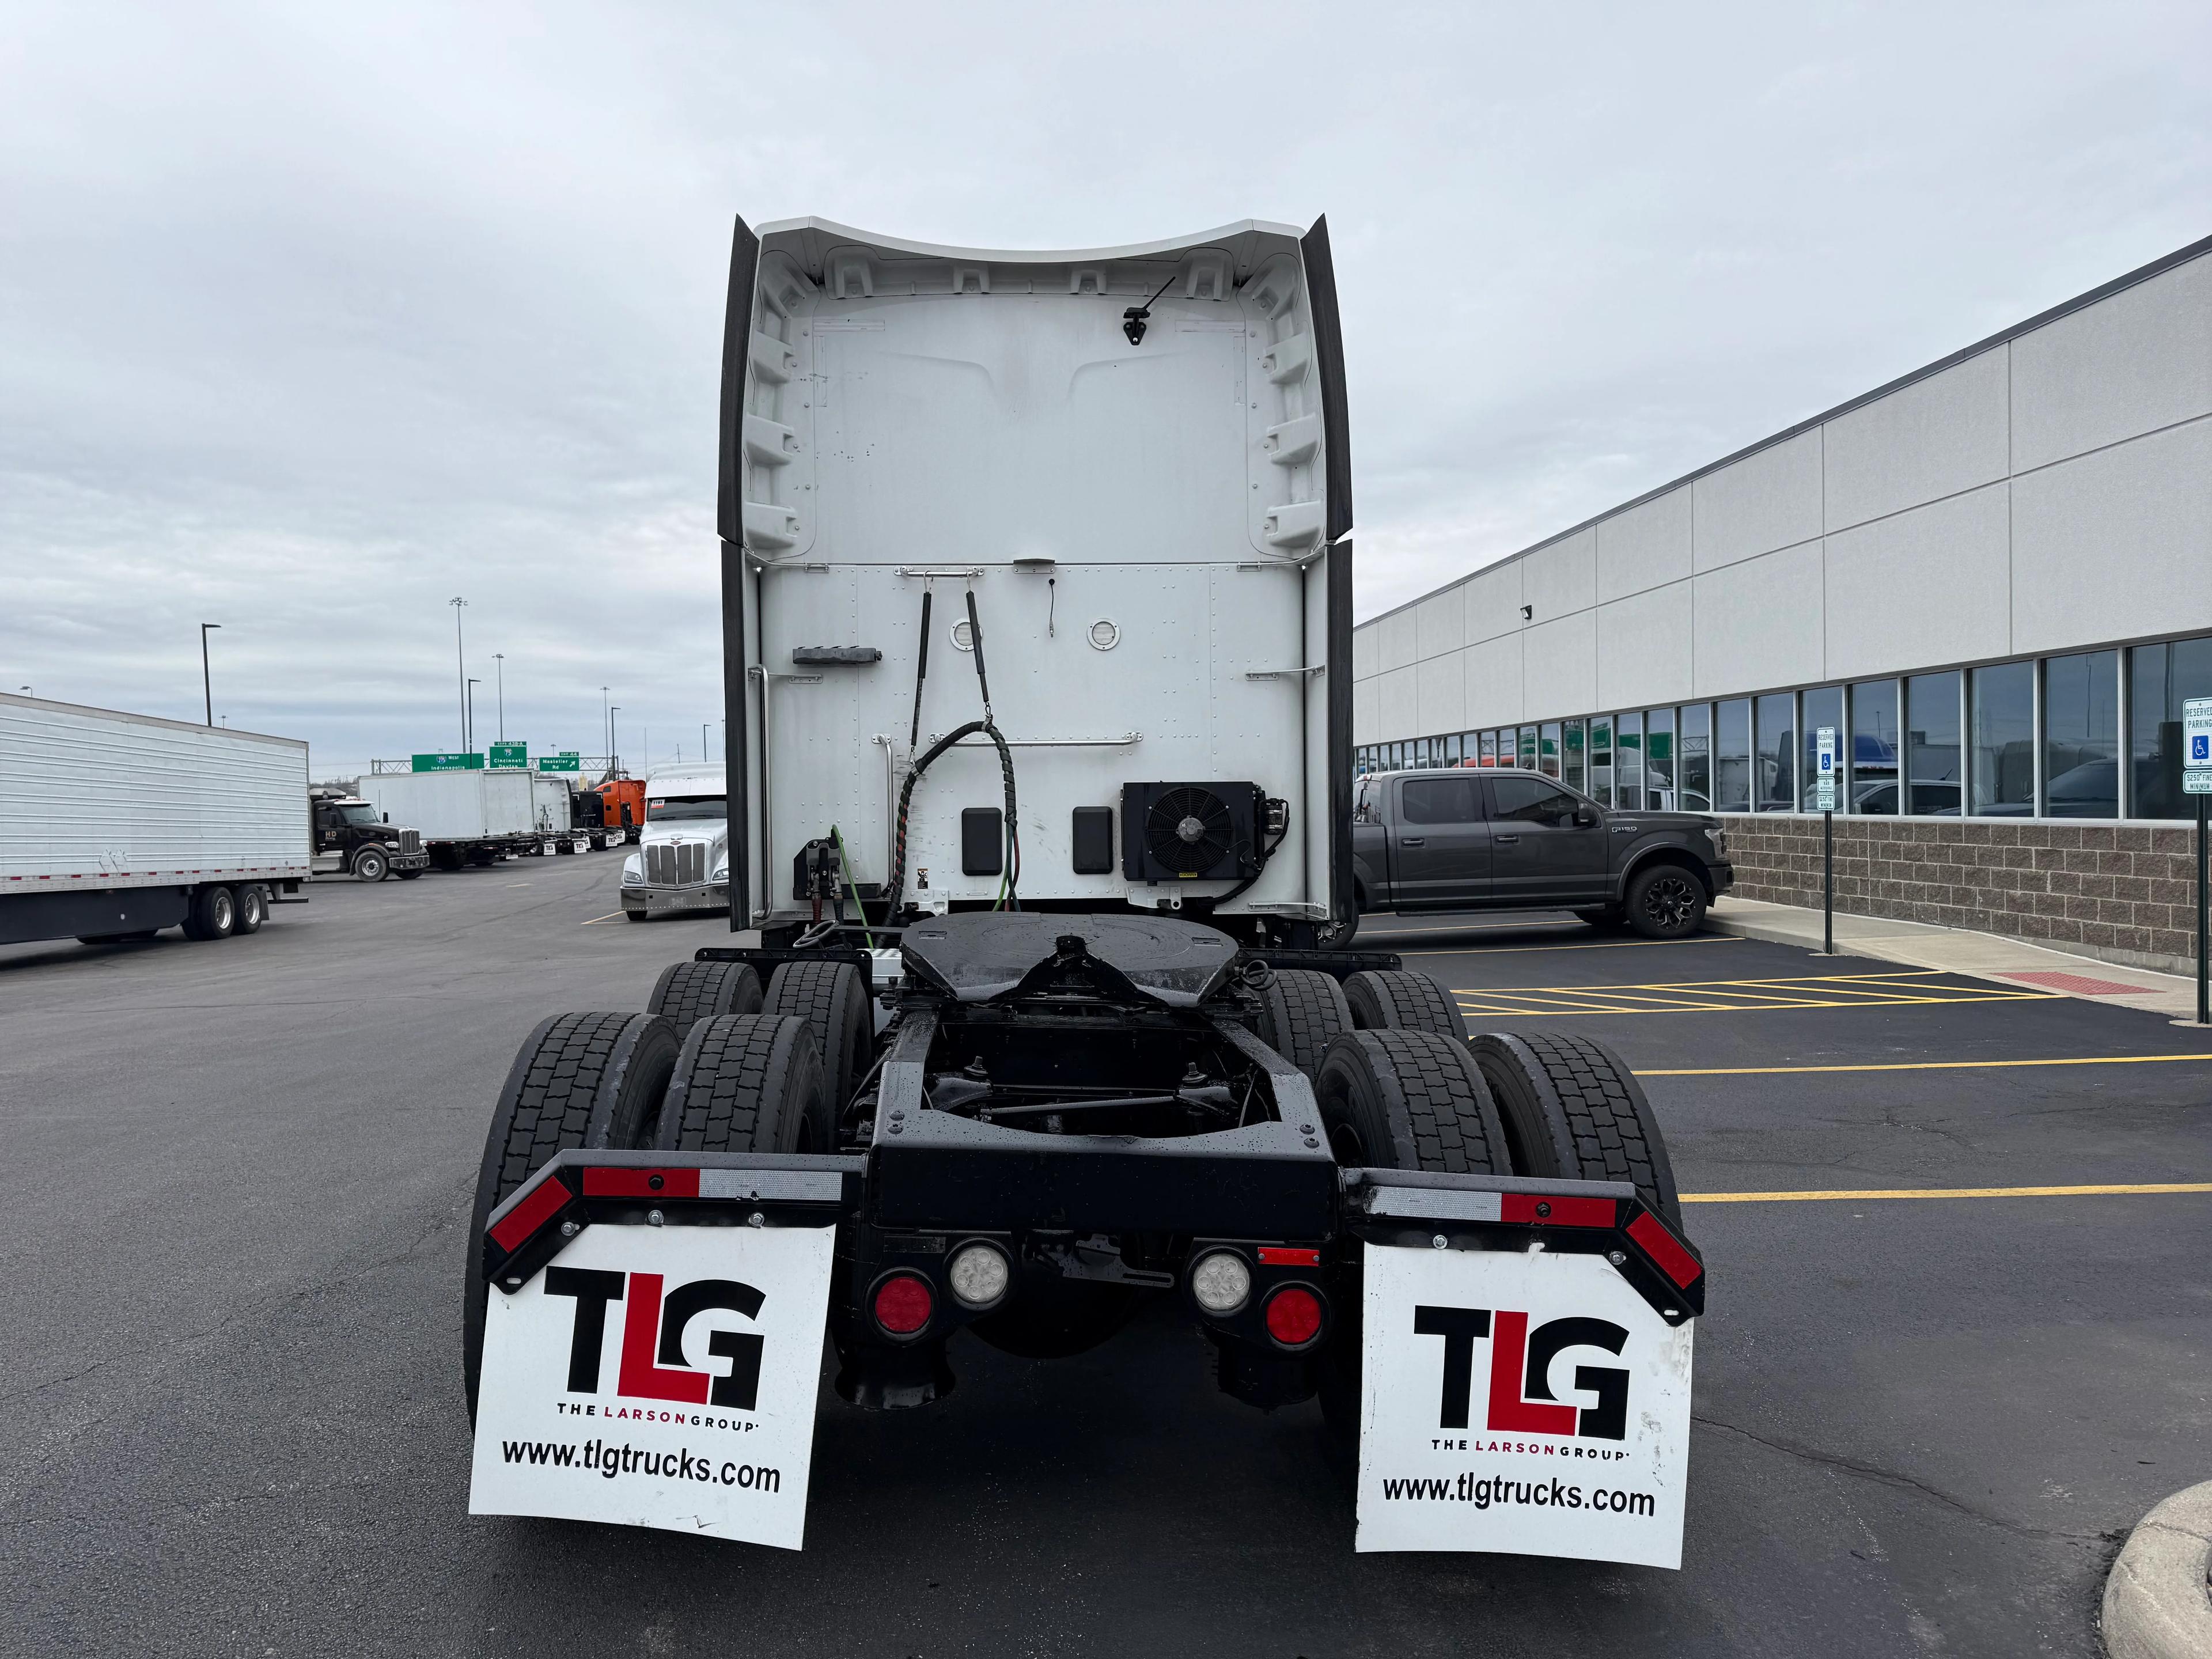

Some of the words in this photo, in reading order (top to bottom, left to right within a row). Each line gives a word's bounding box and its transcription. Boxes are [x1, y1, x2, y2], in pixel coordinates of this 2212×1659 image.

[2186, 707, 2212, 717] RESERVED
[2188, 719, 2212, 729] PARKING
[544, 1266, 767, 1411] TLG
[1414, 1305, 1630, 1441] TLG
[557, 1403, 596, 1416] THE
[1431, 1439, 1467, 1450] THE
[502, 1439, 780, 1493] www.tlgtrucks.com
[1382, 1472, 1656, 1517] www.tlgtrucks.com
